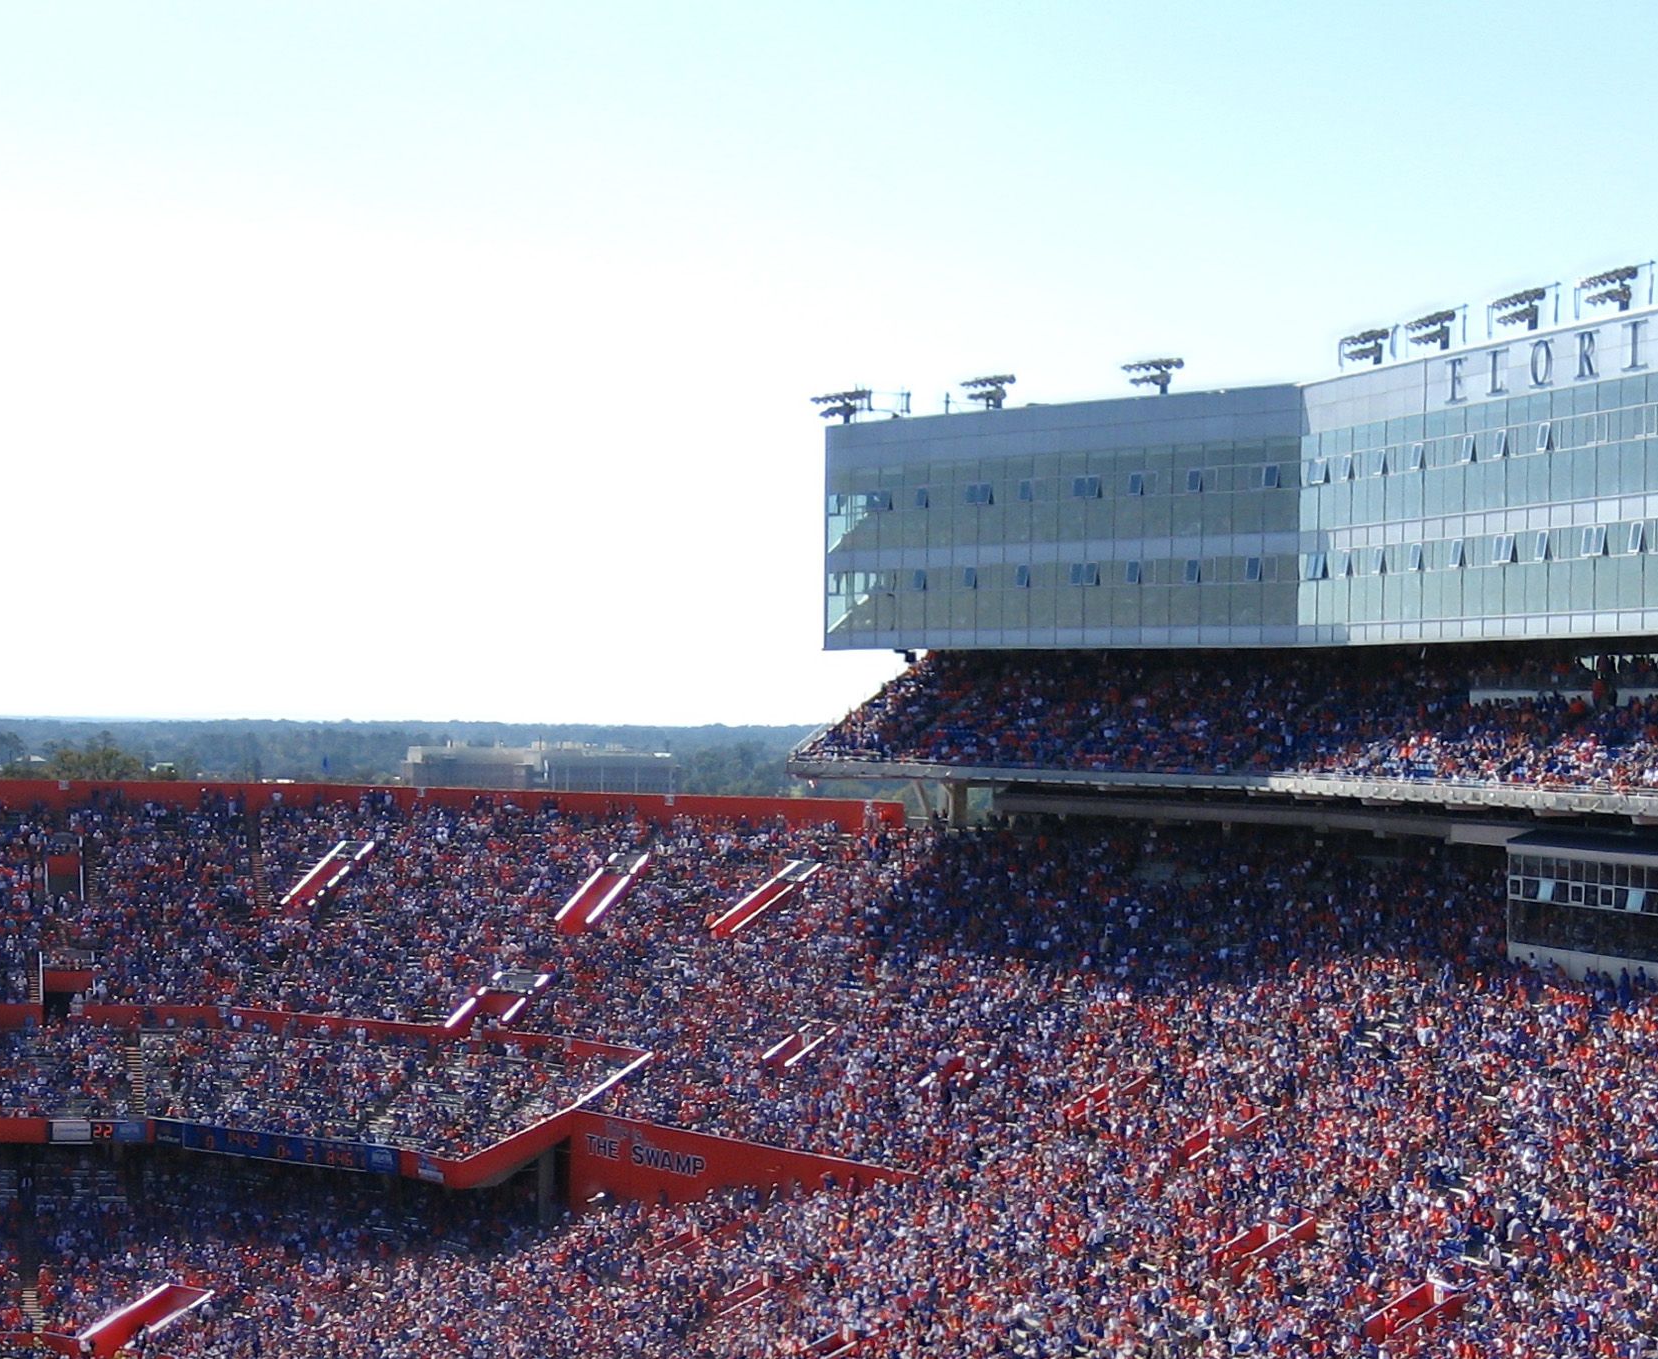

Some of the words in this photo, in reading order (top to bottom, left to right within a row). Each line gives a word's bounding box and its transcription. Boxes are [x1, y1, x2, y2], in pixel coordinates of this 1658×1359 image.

[92, 1124, 114, 1139] 22
[585, 1132, 621, 1161] THE
[631, 1143, 706, 1178] SWAMP
